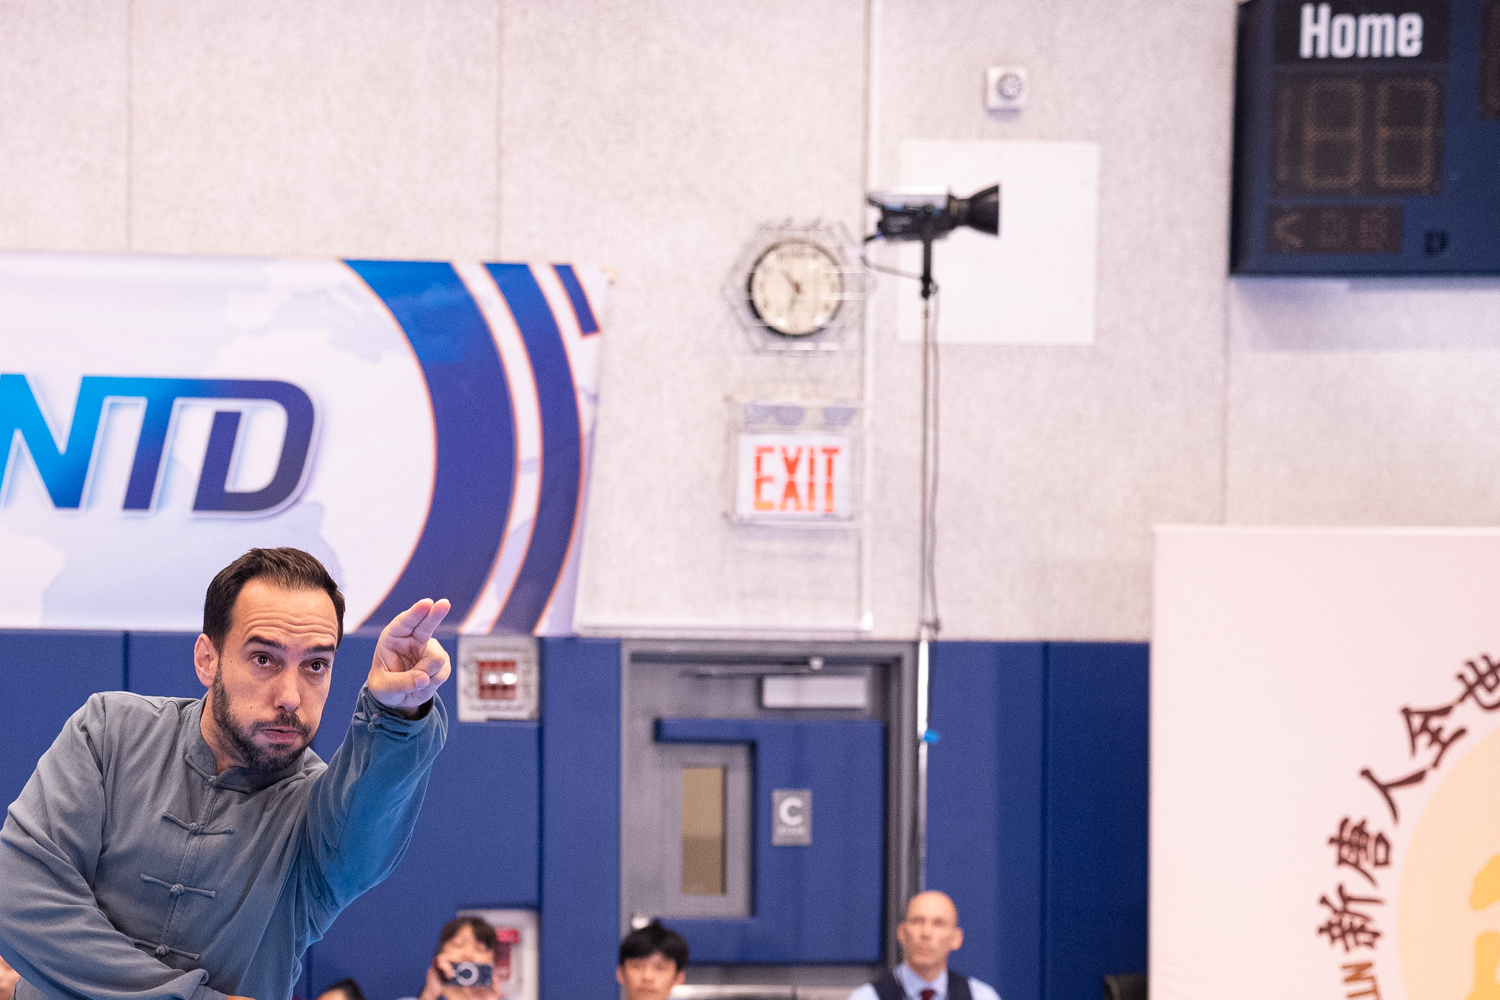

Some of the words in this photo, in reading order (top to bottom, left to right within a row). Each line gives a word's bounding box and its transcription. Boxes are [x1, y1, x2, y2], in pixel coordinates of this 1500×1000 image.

[1300, 3, 1423, 58] Home
[754, 446, 840, 512] EXIT
[779, 796, 804, 826] C
[1317, 654, 1500, 952] 新唐人全世
